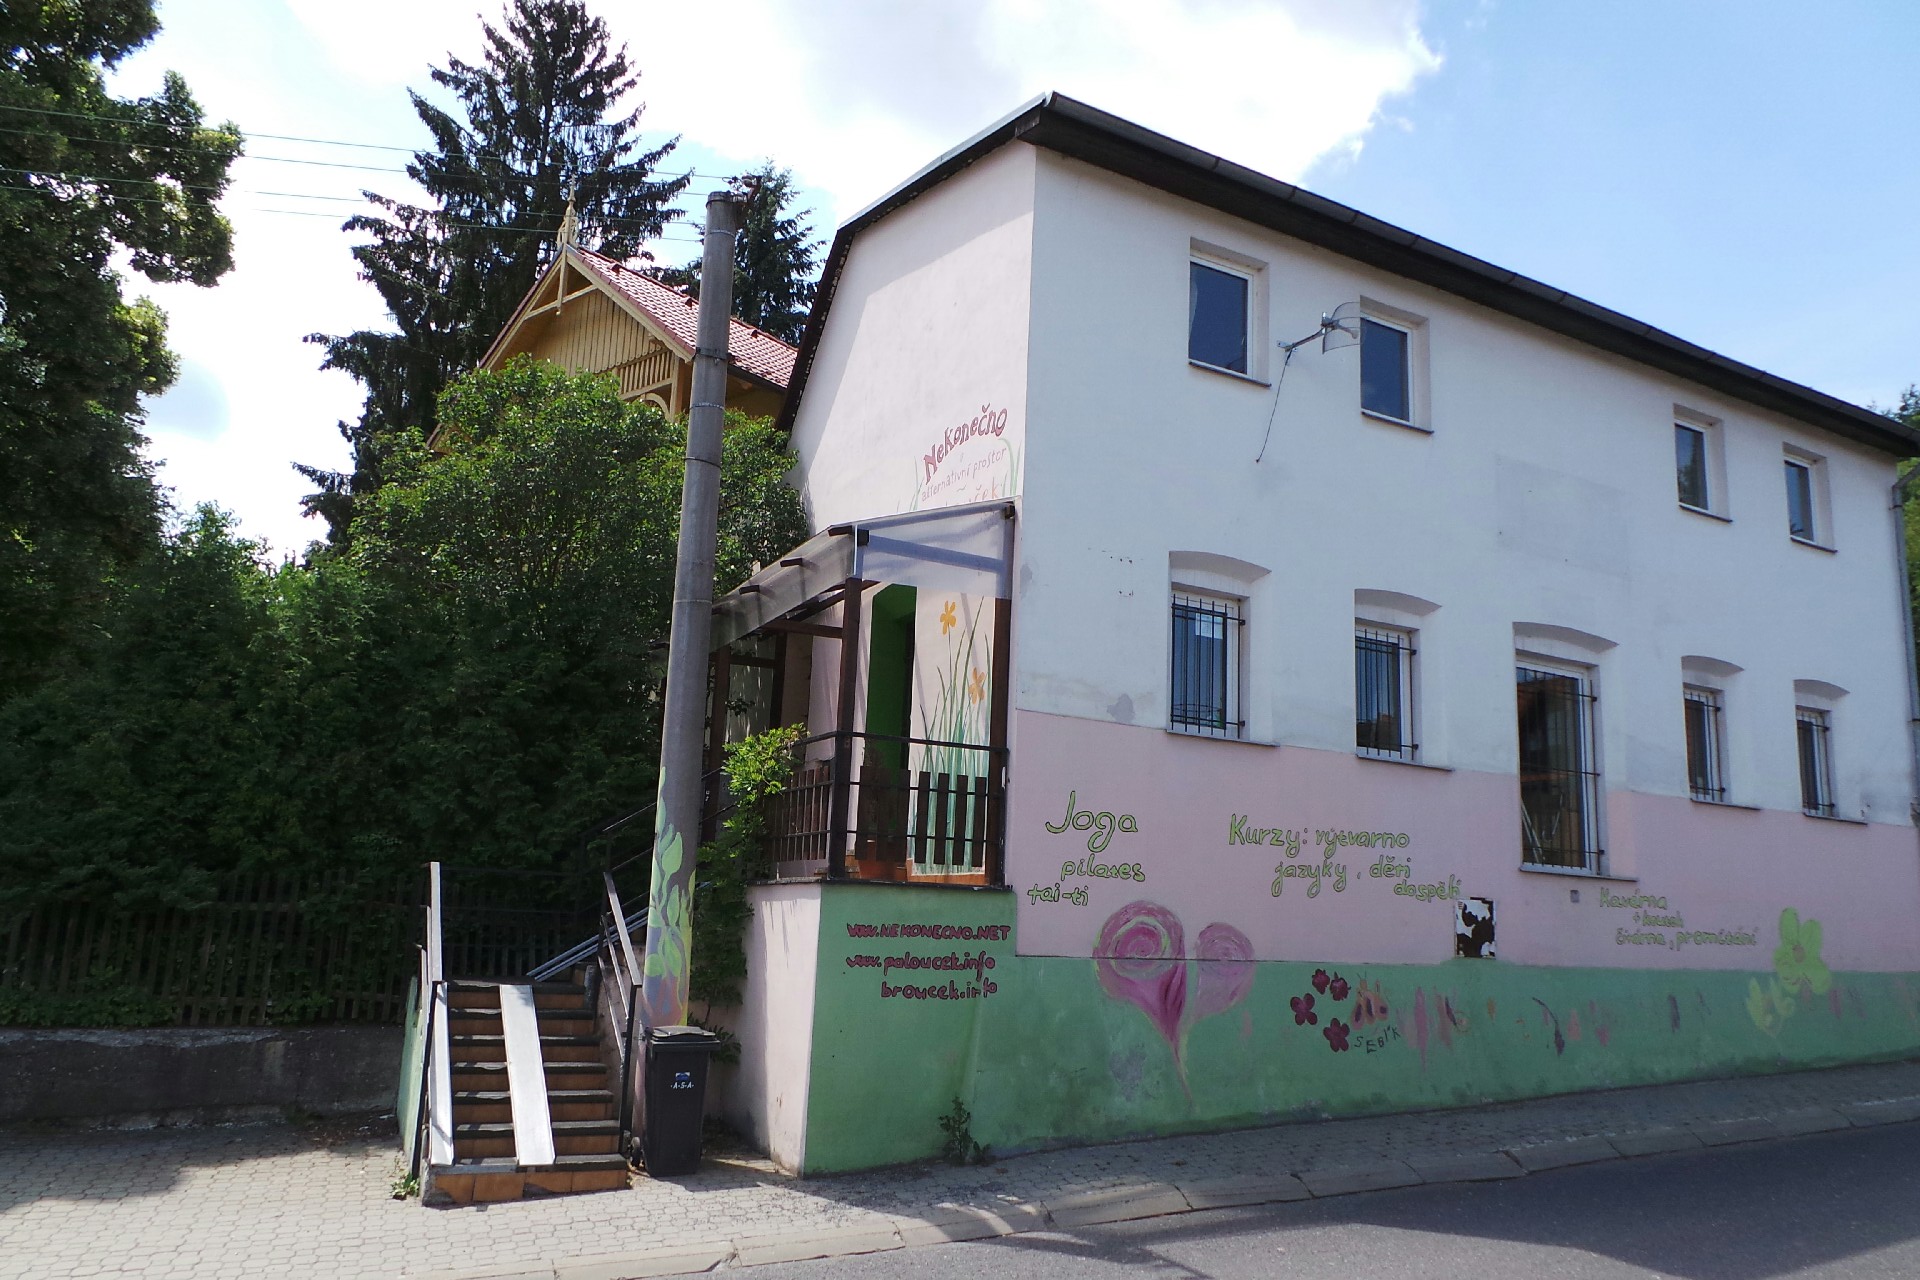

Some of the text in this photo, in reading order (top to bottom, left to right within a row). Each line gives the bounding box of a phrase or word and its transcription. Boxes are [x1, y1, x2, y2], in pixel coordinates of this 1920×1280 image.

[923, 402, 1007, 485] Nekonečno
[973, 447, 1007, 479] prostor
[1045, 790, 1138, 853] Joga
[1229, 813, 1308, 858] Kurzy:
[1060, 853, 1146, 882] pilates
